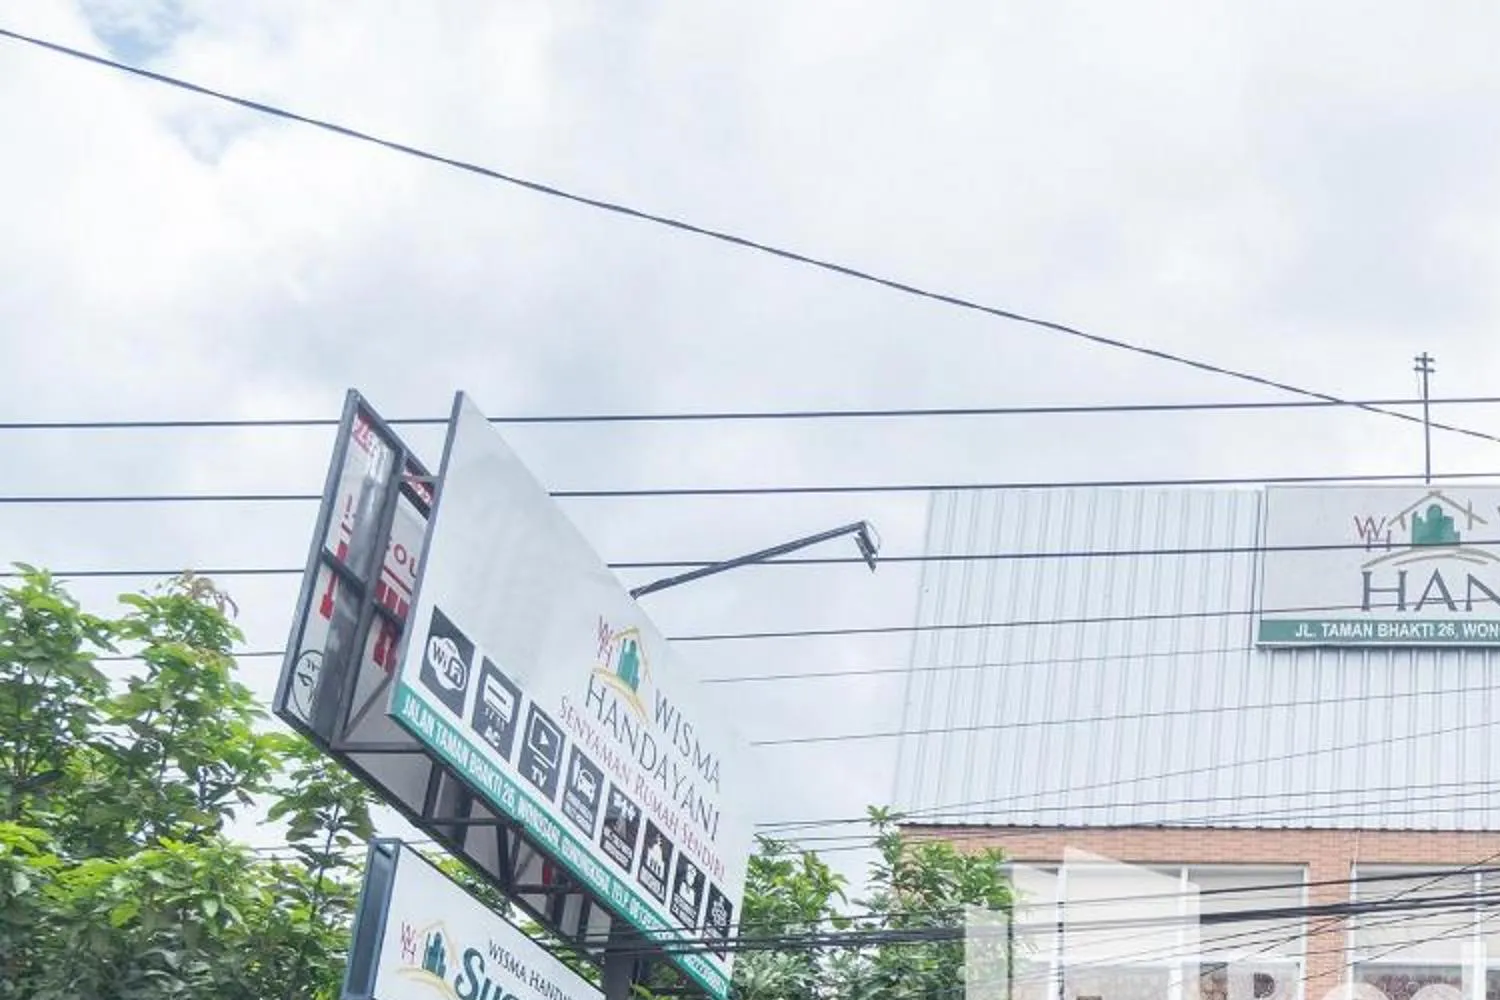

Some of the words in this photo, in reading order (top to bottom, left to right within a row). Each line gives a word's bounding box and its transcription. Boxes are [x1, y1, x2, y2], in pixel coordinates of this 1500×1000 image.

[1321, 622, 1373, 638] TAMAN
[1377, 622, 1434, 638] BHAKTI
[585, 673, 721, 842] HANDAYANI
[653, 687, 721, 794] WISMA
[531, 764, 548, 788] TV
[488, 939, 527, 983] WISMA
